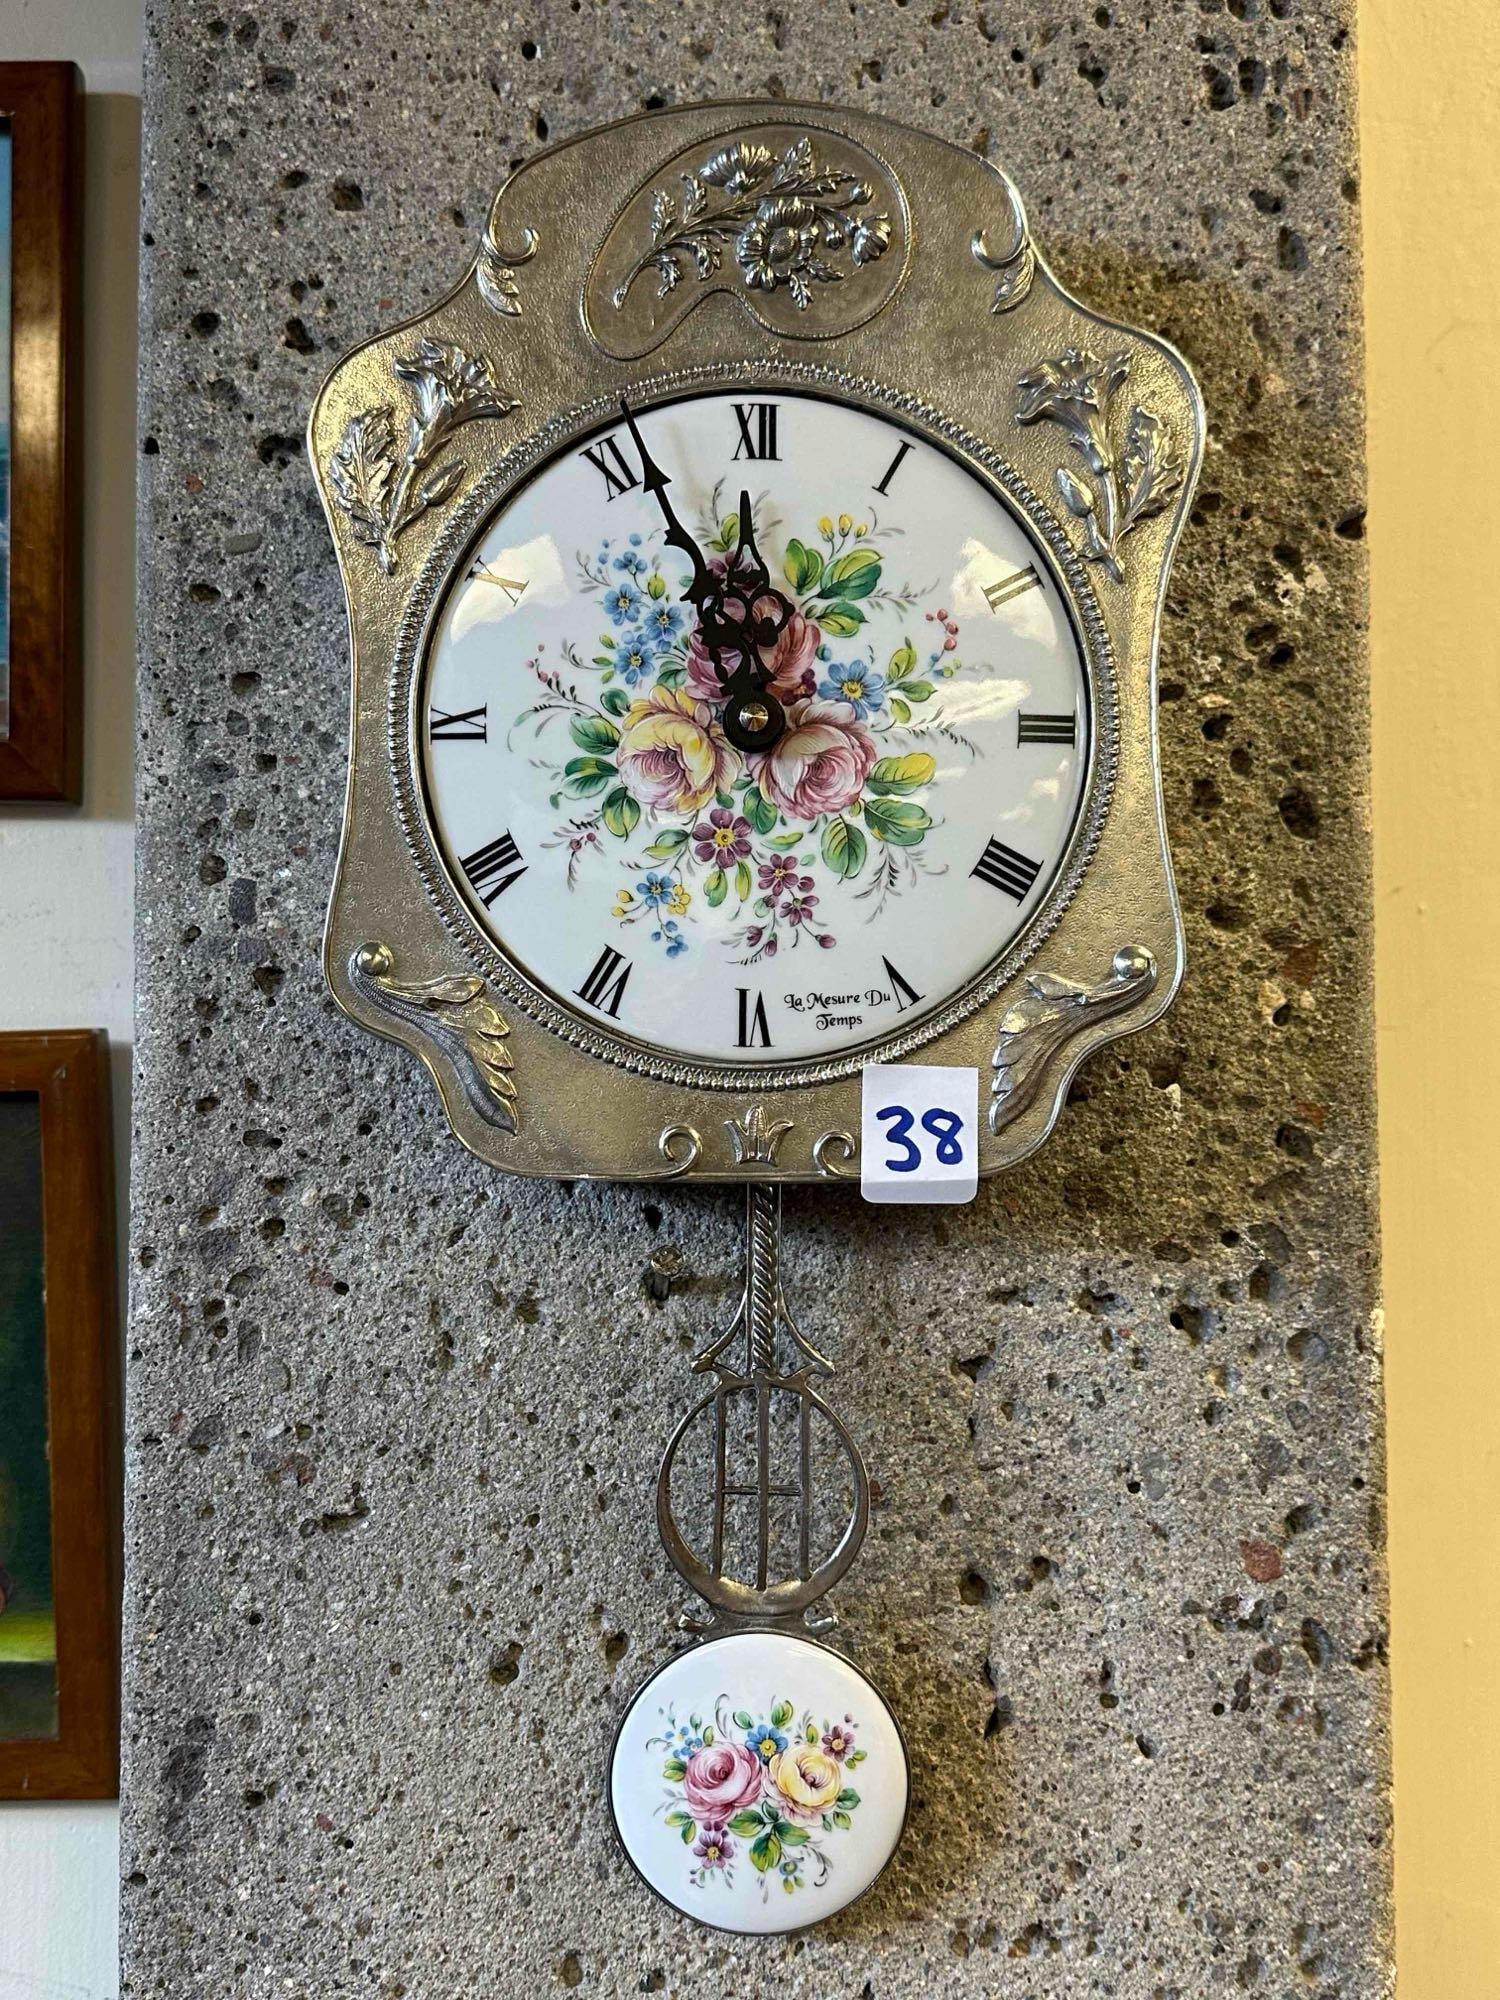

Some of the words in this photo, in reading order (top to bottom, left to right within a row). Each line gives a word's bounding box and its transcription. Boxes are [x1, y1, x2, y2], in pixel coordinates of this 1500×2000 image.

[731, 403, 783, 461] XII
[579, 434, 642, 502] XI
[872, 440, 916, 496] I
[465, 555, 530, 607] X
[980, 561, 1045, 614] II
[969, 834, 1044, 907] IIII
[784, 993, 805, 1012] La
[806, 992, 860, 1010] Mesure
[864, 989, 891, 1007] Du
[815, 1013, 863, 1031] Temps
[876, 1105, 964, 1172] 38
